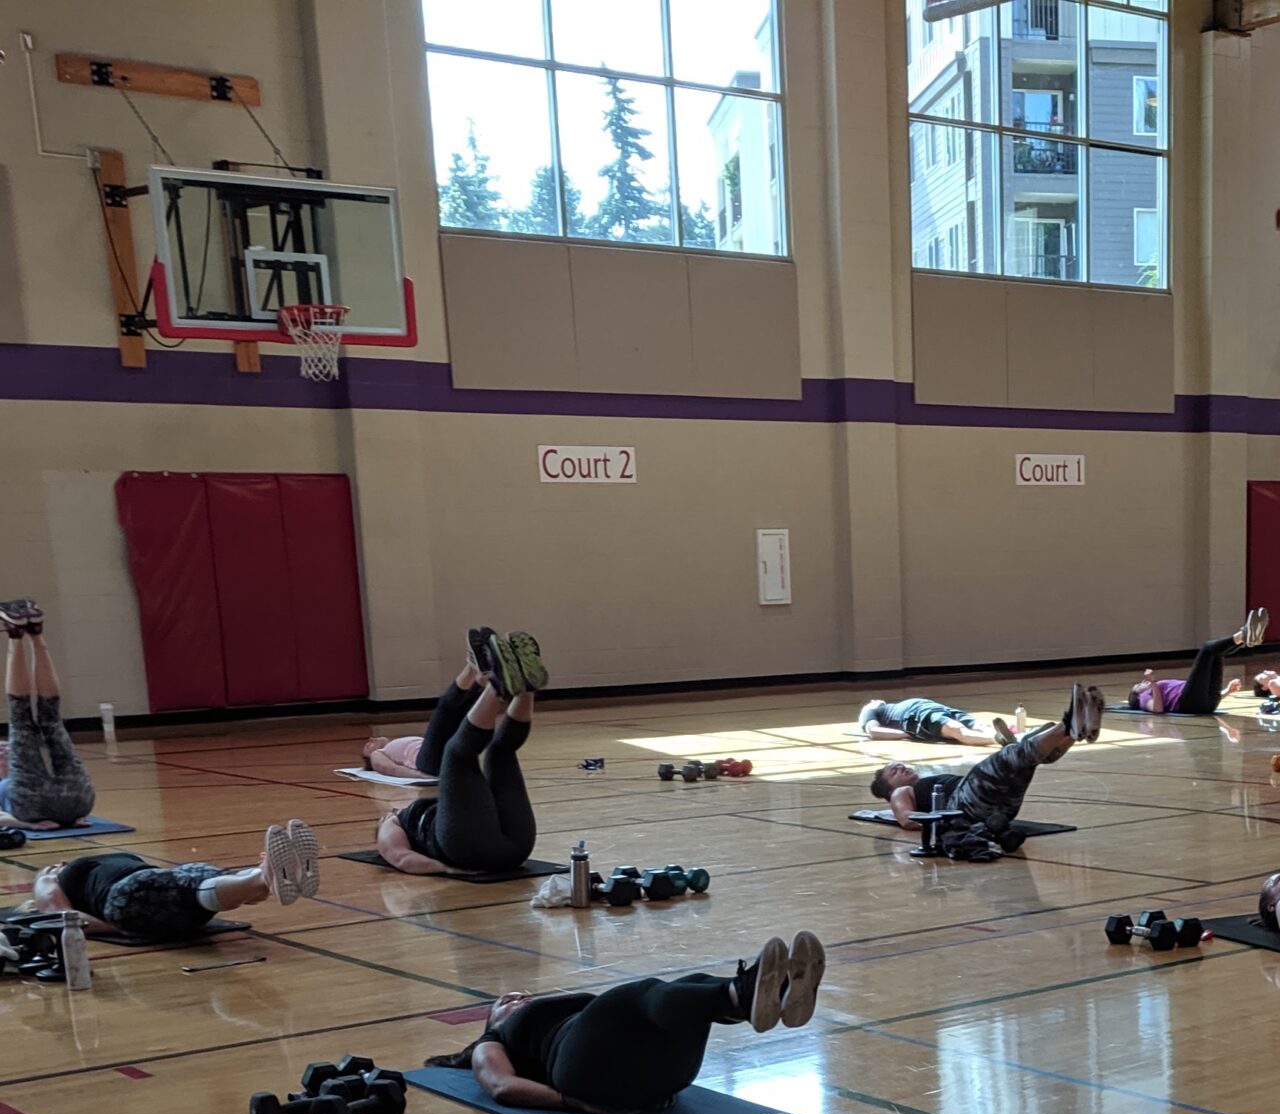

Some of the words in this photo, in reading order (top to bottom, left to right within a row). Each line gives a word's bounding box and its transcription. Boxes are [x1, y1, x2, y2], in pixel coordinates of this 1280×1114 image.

[542, 448, 611, 479] Court
[618, 449, 634, 479] 2
[1019, 456, 1068, 482] Court
[1077, 457, 1082, 482] 1
